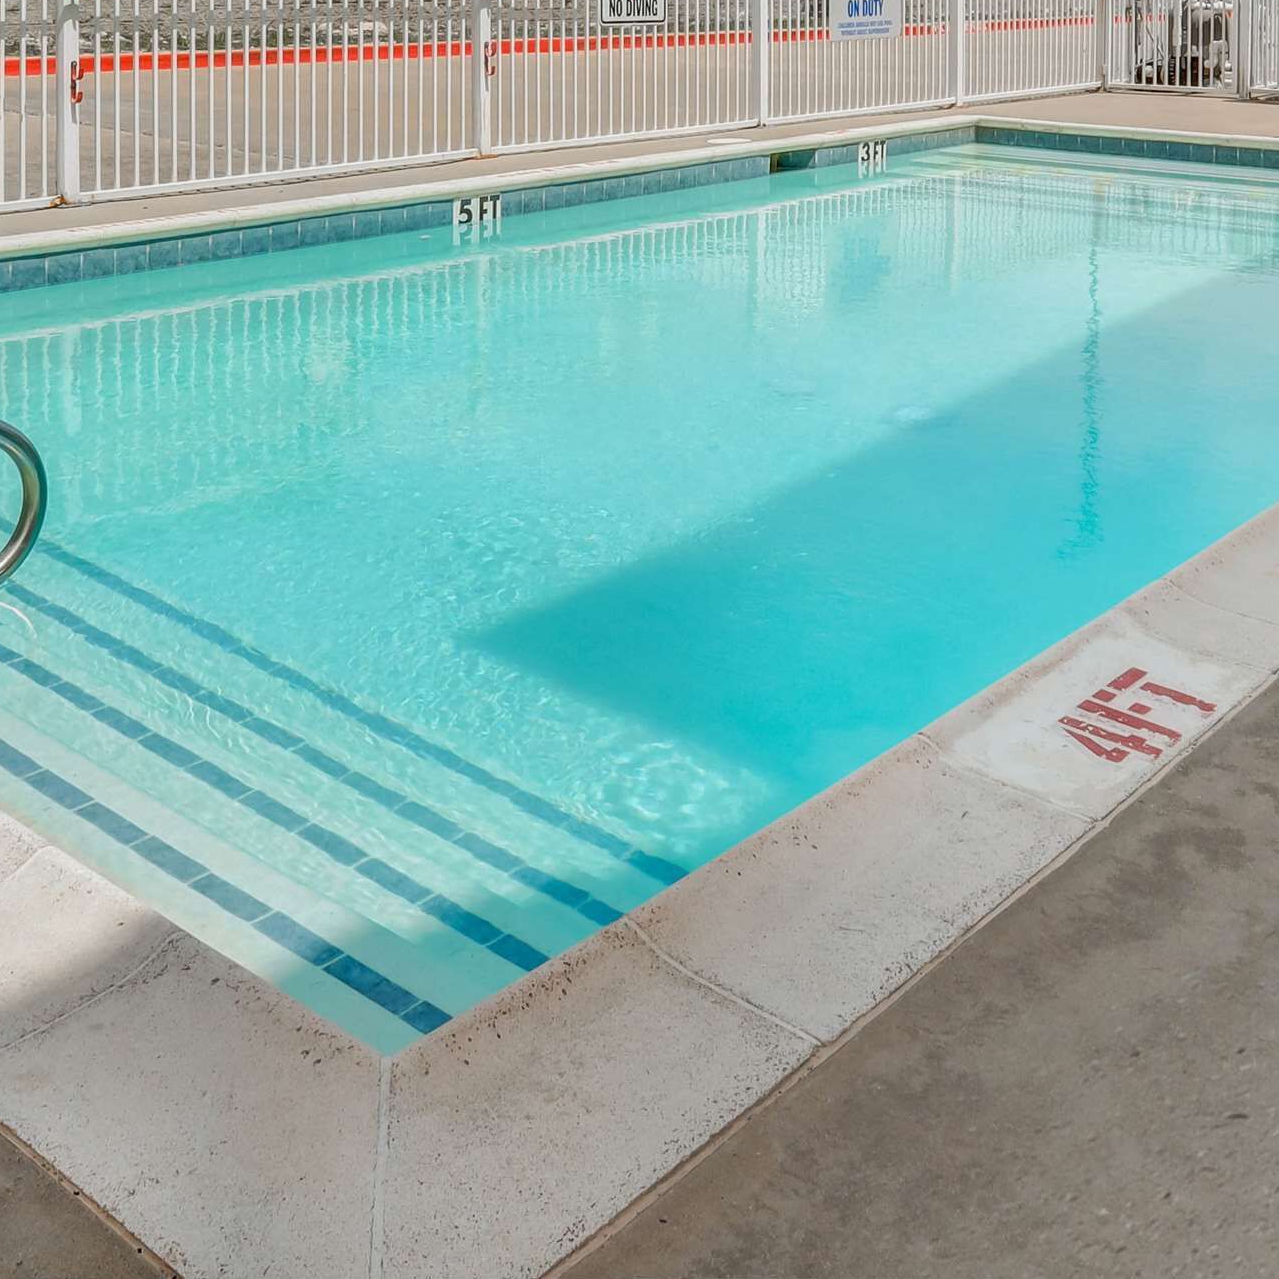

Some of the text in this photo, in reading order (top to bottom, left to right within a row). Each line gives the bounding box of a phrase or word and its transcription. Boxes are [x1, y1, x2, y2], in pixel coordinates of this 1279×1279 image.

[609, 0, 623, 17] NO
[848, 0, 860, 18] ON
[861, 140, 886, 162] 3 FT
[458, 194, 500, 224] 5 FT
